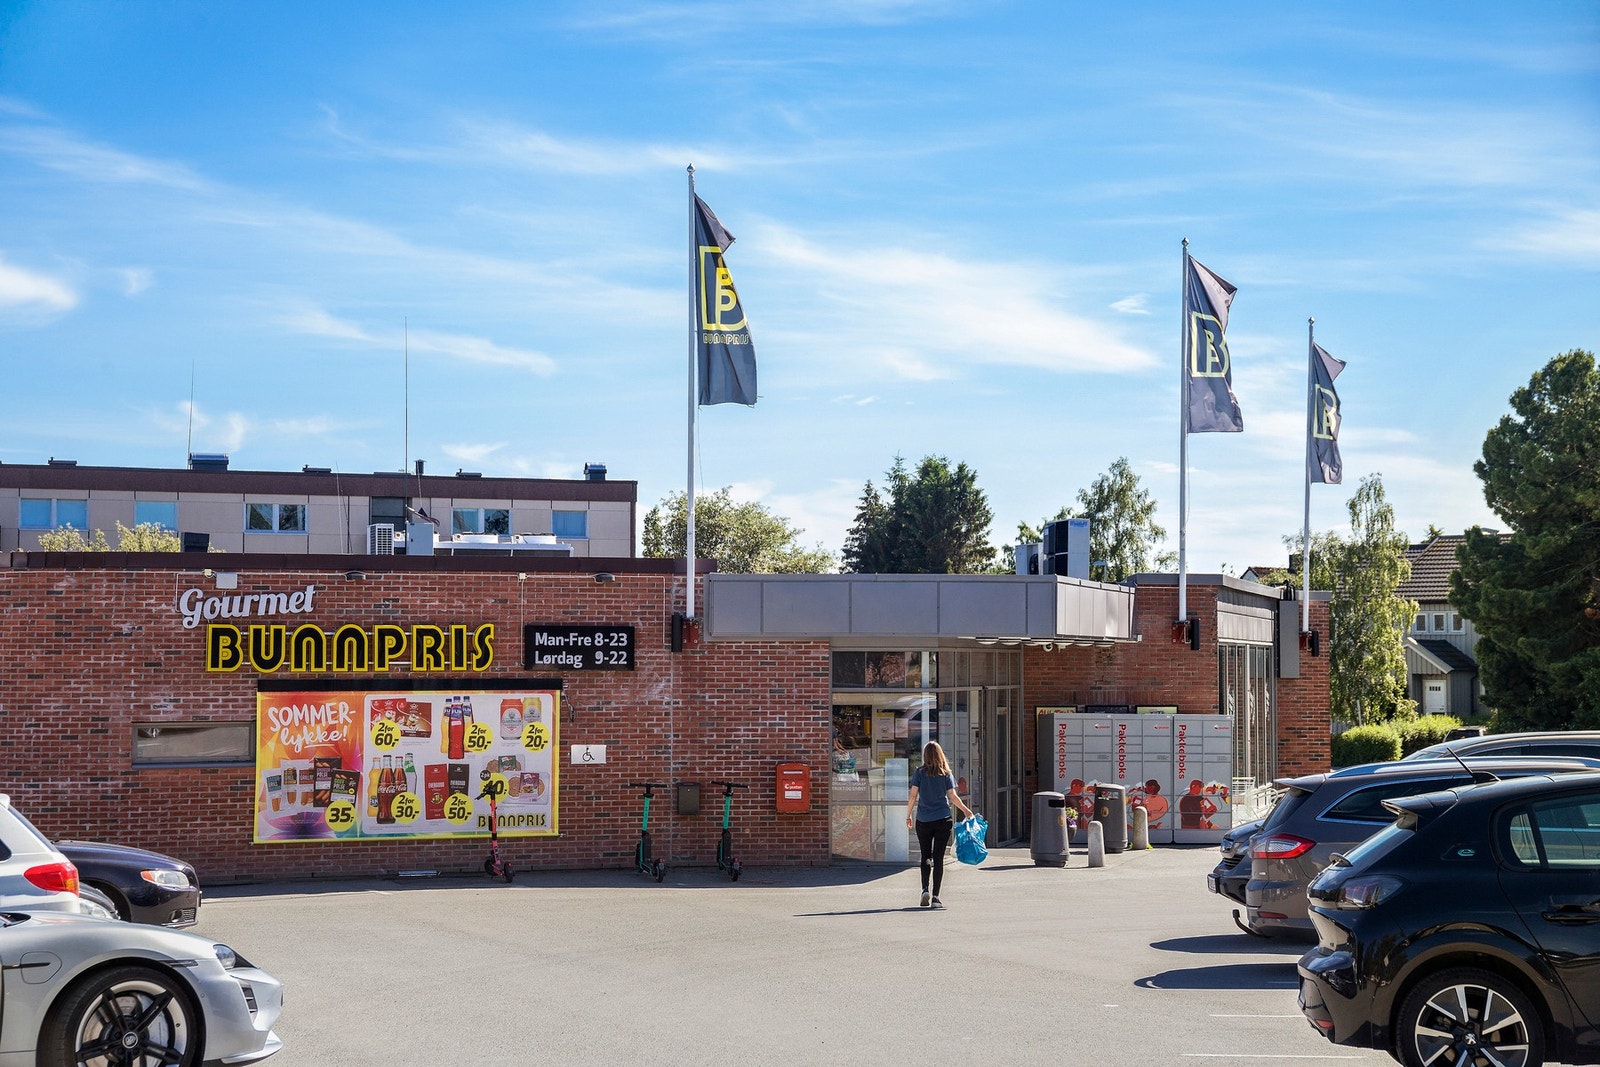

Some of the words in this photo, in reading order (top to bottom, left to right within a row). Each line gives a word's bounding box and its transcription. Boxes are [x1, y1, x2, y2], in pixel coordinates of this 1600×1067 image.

[179, 584, 316, 629] Gourmet
[206, 622, 496, 674] BUNNPRIS
[535, 631, 592, 648] Man-Fre
[594, 631, 628, 648] 8-23
[534, 650, 583, 670] Lørdag
[594, 650, 628, 666] 9-22
[280, 725, 348, 753] lykke!
[374, 733, 399, 747] 60,-
[467, 735, 491, 750] 50,-
[525, 735, 548, 750] 20,-
[1058, 723, 1067, 779] Pakkeboks
[1118, 724, 1127, 780] Pakkeboks
[1177, 724, 1186, 780] Pakkeboks
[395, 805, 420, 819] 30,-
[447, 806, 472, 821] 50,-
[477, 813, 547, 829] BNNPRIS
